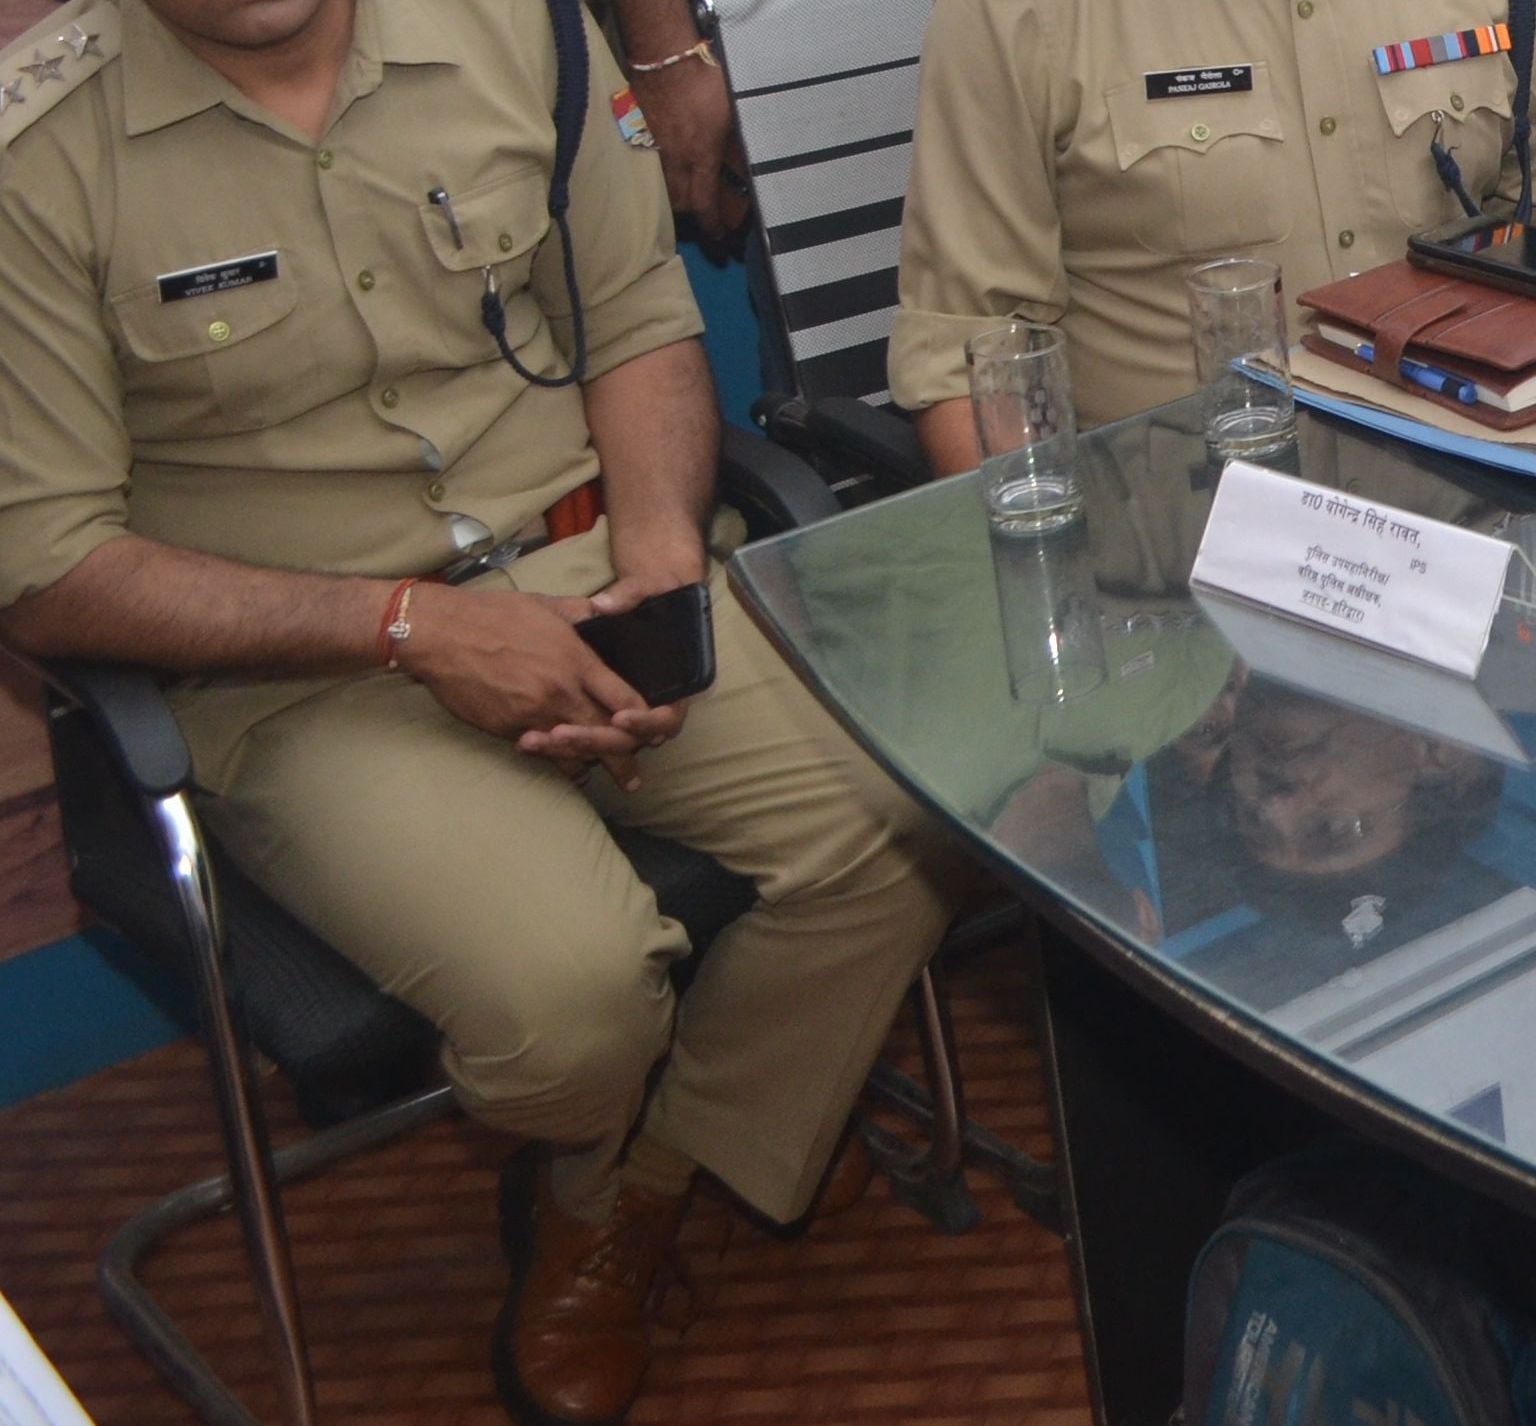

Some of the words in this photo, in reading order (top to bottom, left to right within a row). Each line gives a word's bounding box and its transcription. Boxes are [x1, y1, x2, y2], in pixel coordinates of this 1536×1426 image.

[1304, 545, 1330, 563] पुलिस
[1410, 558, 1427, 574] IPS
[1320, 572, 1345, 592] पुलिस
